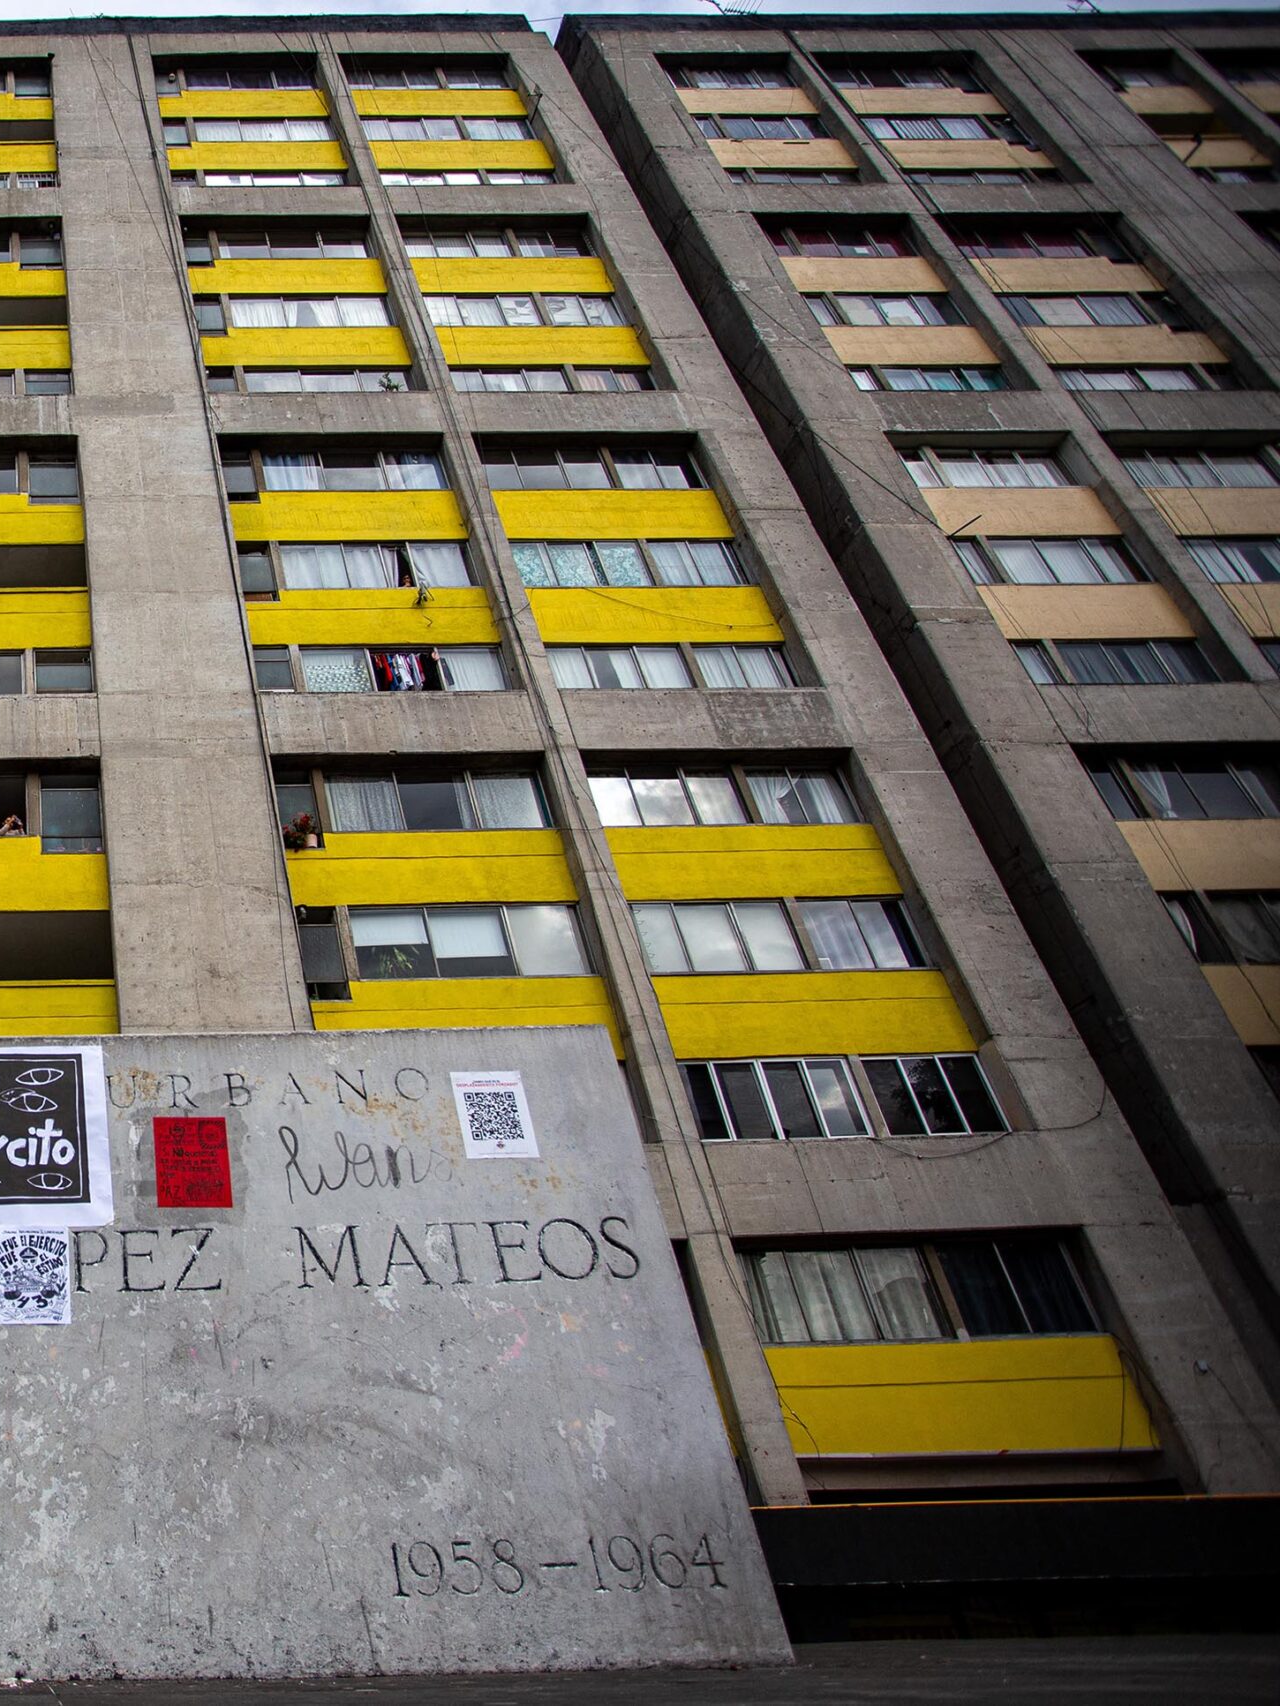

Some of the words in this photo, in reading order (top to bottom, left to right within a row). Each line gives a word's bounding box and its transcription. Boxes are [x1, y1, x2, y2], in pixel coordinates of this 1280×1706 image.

[106, 1067, 429, 1110] URBANO
[0, 1251, 19, 1270] FUE
[291, 1215, 641, 1291] MATEOS
